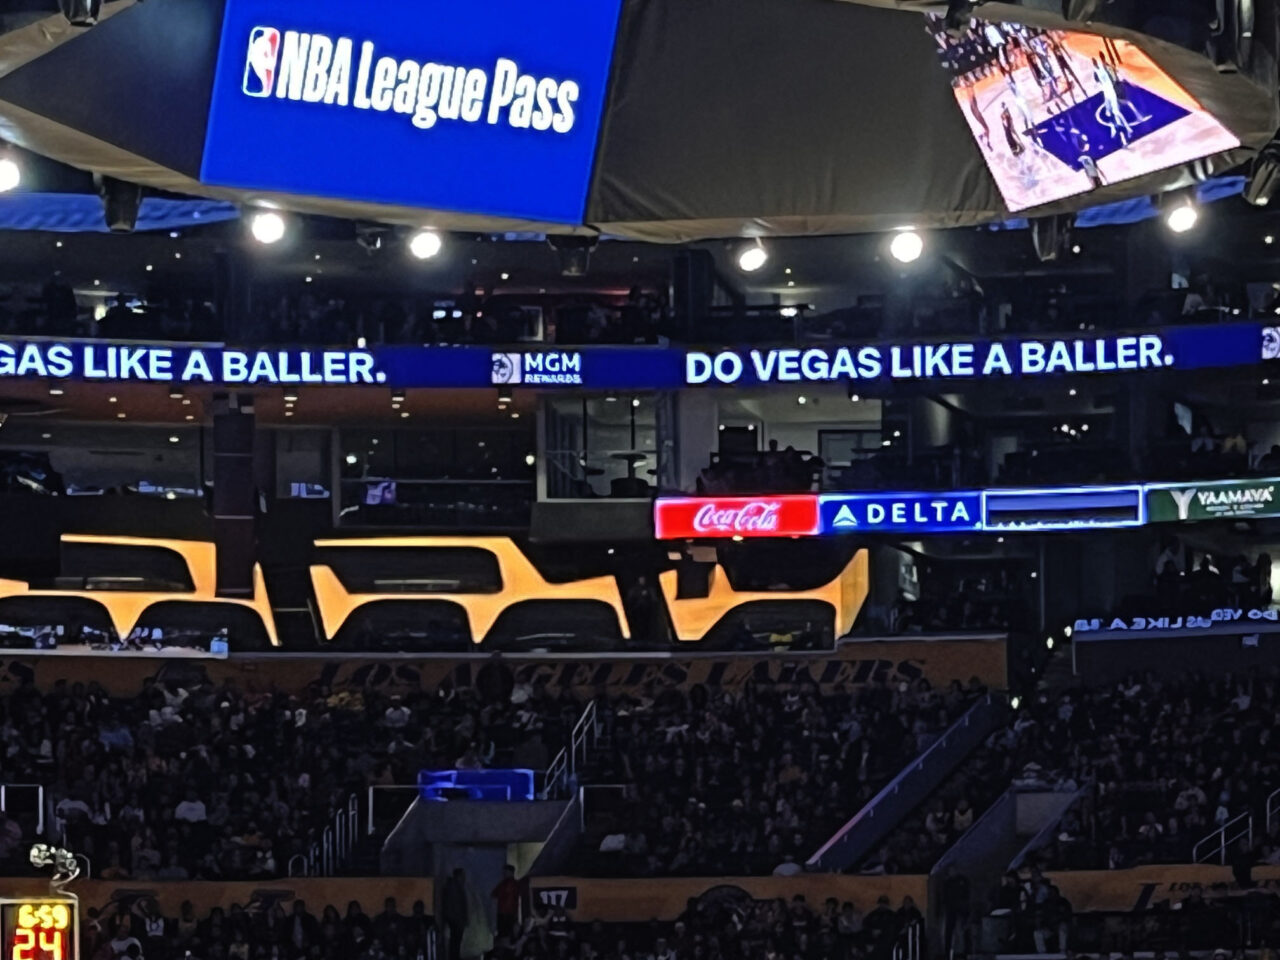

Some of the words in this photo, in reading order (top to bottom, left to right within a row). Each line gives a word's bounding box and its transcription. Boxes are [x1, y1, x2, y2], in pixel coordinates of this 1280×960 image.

[276, 30, 352, 107] NBA
[353, 40, 488, 129] League
[487, 58, 580, 133] Pass
[84, 346, 174, 380] LIKE
[182, 347, 214, 382] A
[223, 348, 387, 383] BALLER.
[525, 352, 581, 371] MGM
[687, 352, 742, 384] DO
[750, 347, 882, 381] VEGAS
[891, 344, 974, 377] LIKE
[983, 343, 1012, 375] A
[1021, 335, 1174, 373] BALLER.
[525, 373, 582, 384] REWARDS
[867, 500, 971, 524] DELTA
[539, 890, 569, 908] 117
[18, 904, 69, 930] 6:59
